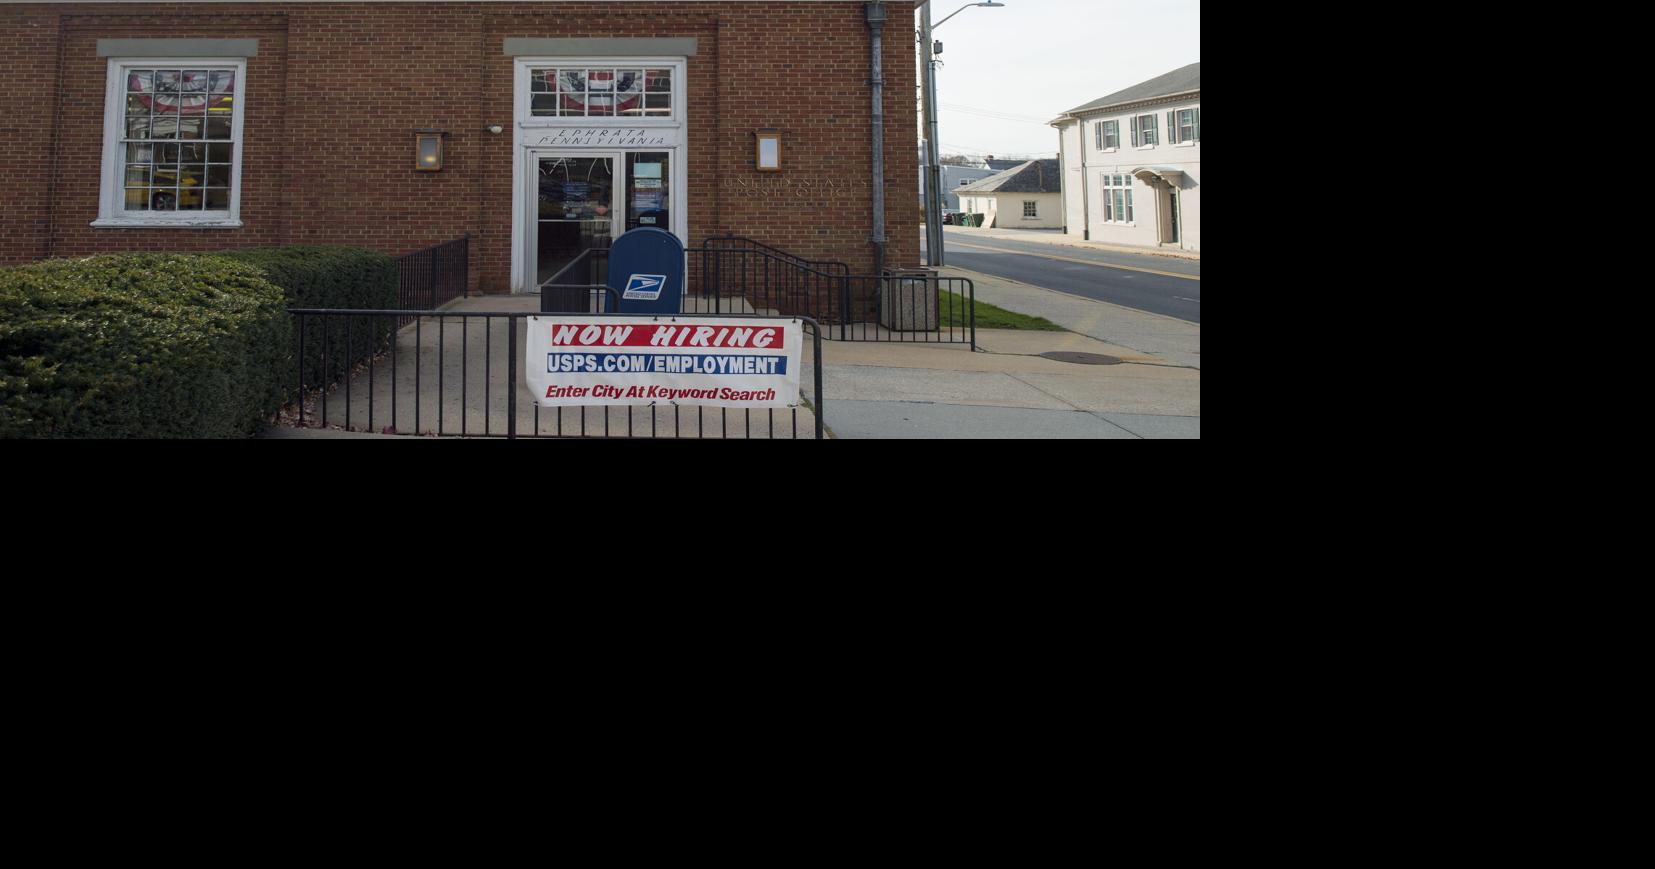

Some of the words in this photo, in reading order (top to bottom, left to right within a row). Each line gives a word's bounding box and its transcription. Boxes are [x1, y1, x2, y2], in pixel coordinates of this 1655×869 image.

[538, 137, 665, 145] PENNSYLVANIA
[558, 129, 645, 137] EPHRATA
[553, 325, 633, 346] NOW
[650, 326, 776, 348] HIRING
[548, 354, 779, 374] USPS.COM/EMPLOYMENT
[545, 385, 588, 398] Enter
[592, 385, 622, 400] City
[625, 385, 645, 398] At
[646, 386, 718, 400] Keyword
[719, 387, 776, 401] Search
